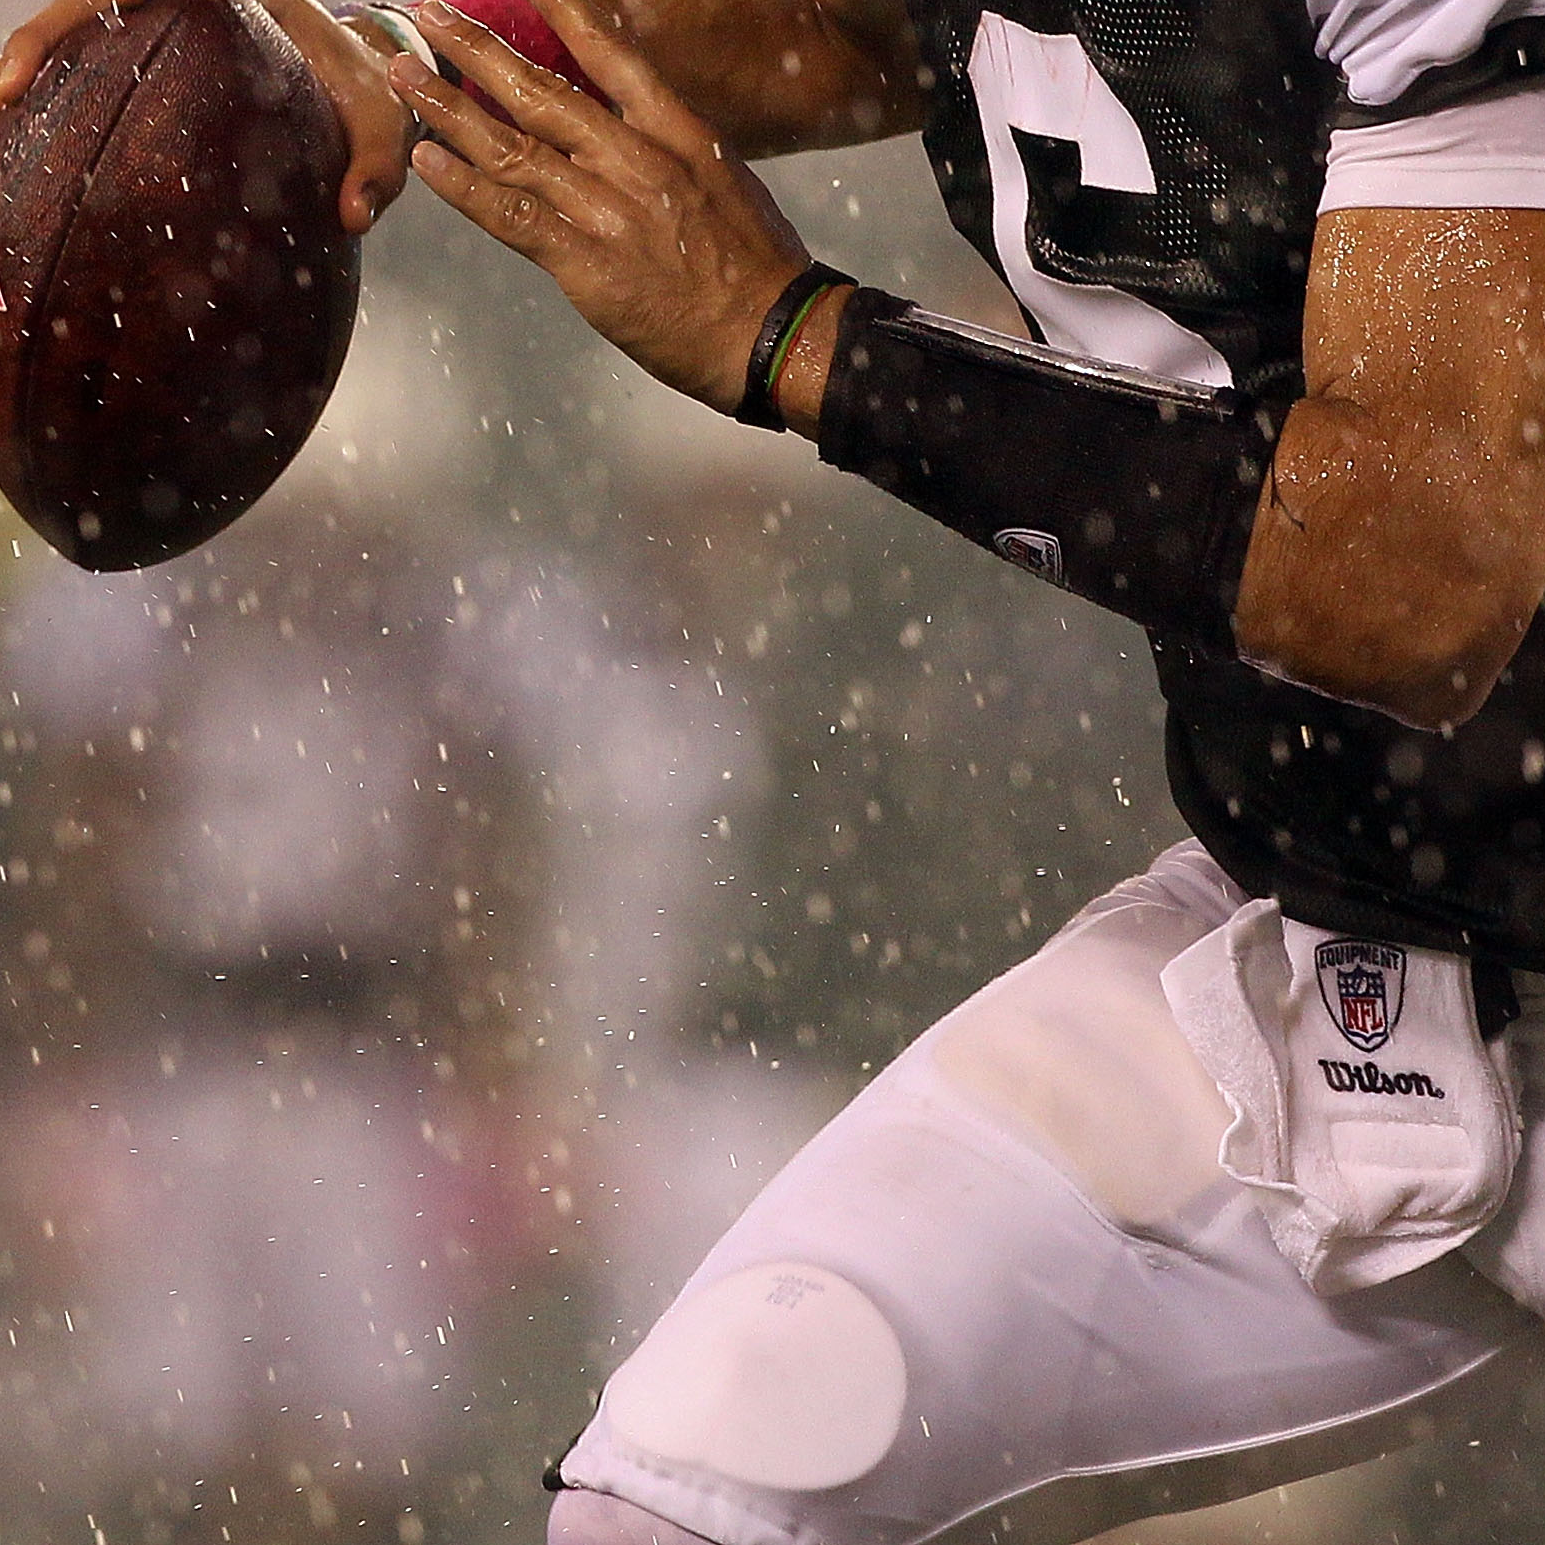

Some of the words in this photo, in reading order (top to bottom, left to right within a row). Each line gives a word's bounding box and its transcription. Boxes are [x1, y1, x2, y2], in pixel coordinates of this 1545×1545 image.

[1318, 944, 1401, 971] EQUIPMENT
[1343, 997, 1384, 1033] NFL
[1318, 1059, 1440, 1098] Wilson
